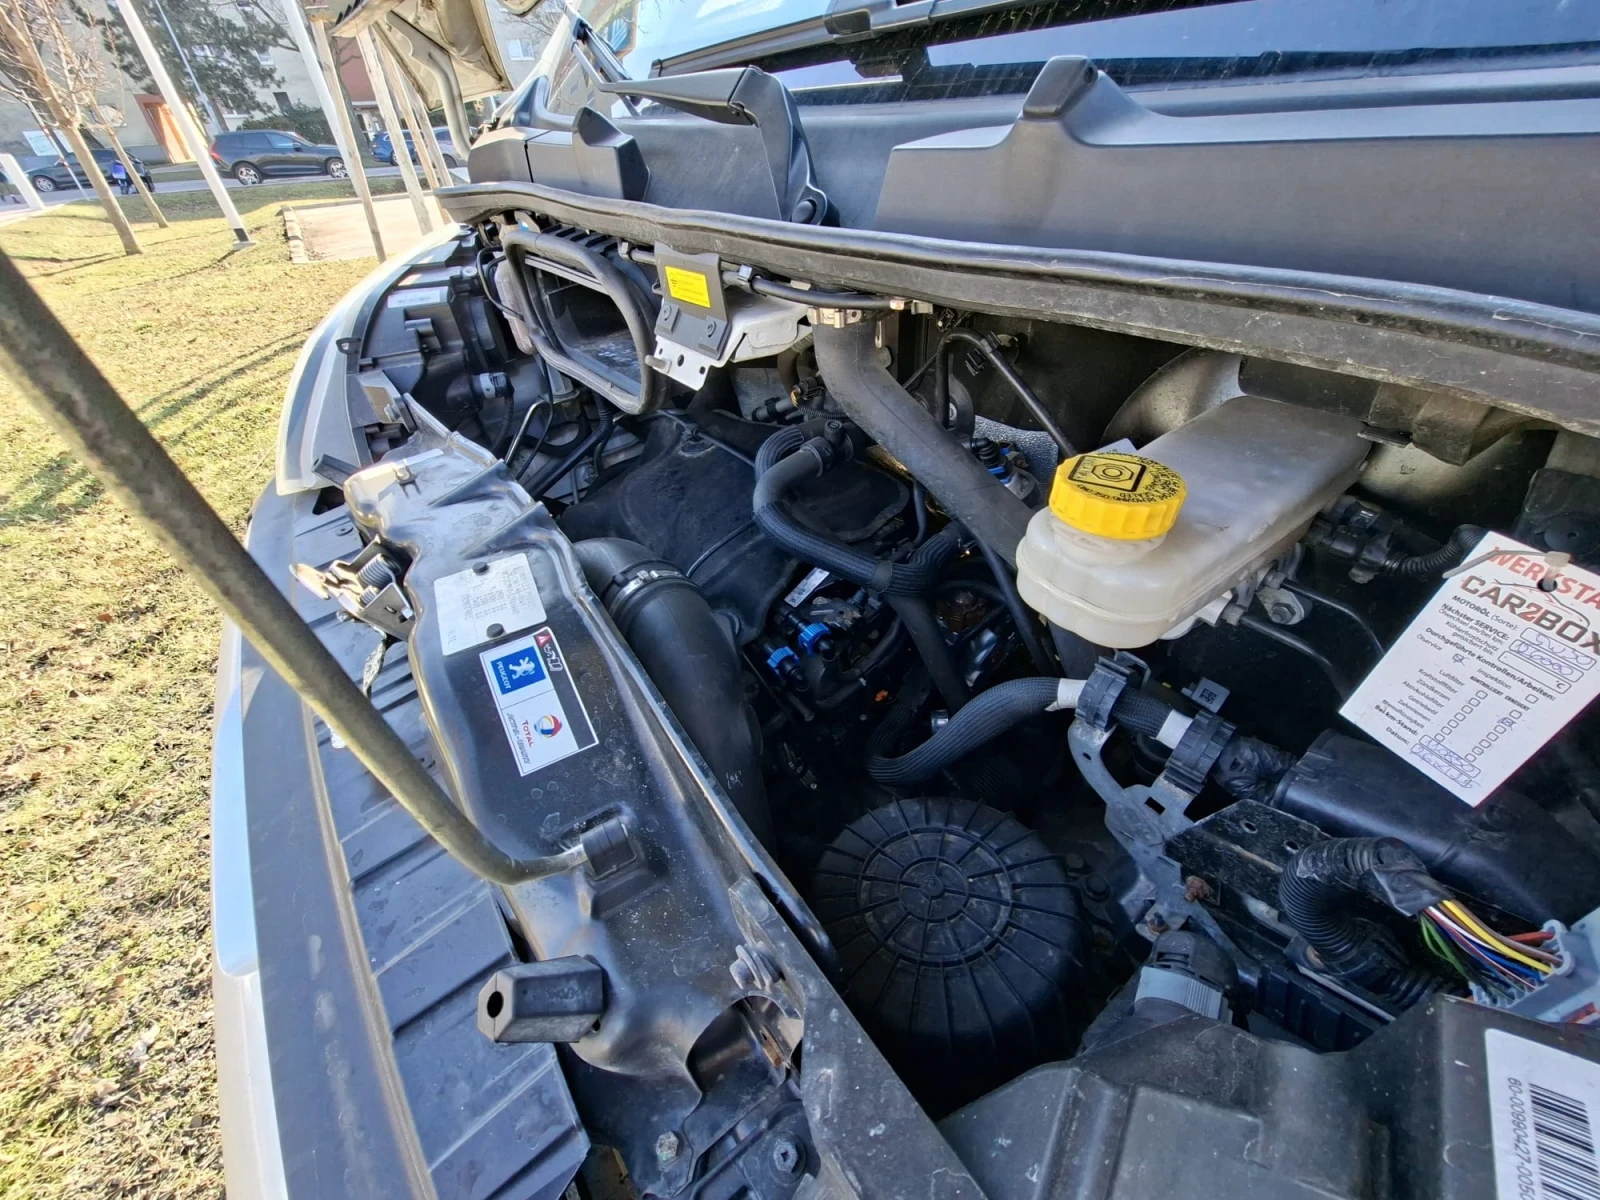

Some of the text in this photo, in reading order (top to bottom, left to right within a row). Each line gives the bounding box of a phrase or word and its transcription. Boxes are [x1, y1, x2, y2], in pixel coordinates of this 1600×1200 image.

[1487, 547, 1600, 607] WERSTA
[1441, 603, 1510, 639] Nächster SERVICE:
[1452, 594, 1519, 630] MOTORÖL (Sorte):
[1460, 575, 1600, 655] CAR2BOX
[496, 661, 511, 689] PEUGEOT
[1425, 627, 1557, 700] Durchgeführte Kontrollen/Arbeiten:
[1438, 670, 1465, 686] Luftfilter
[1477, 668, 1511, 689] Inspektion
[522, 719, 534, 747] TOTAL
[1385, 712, 1418, 735] km-Stand:
[1386, 727, 1409, 744] Datum:
